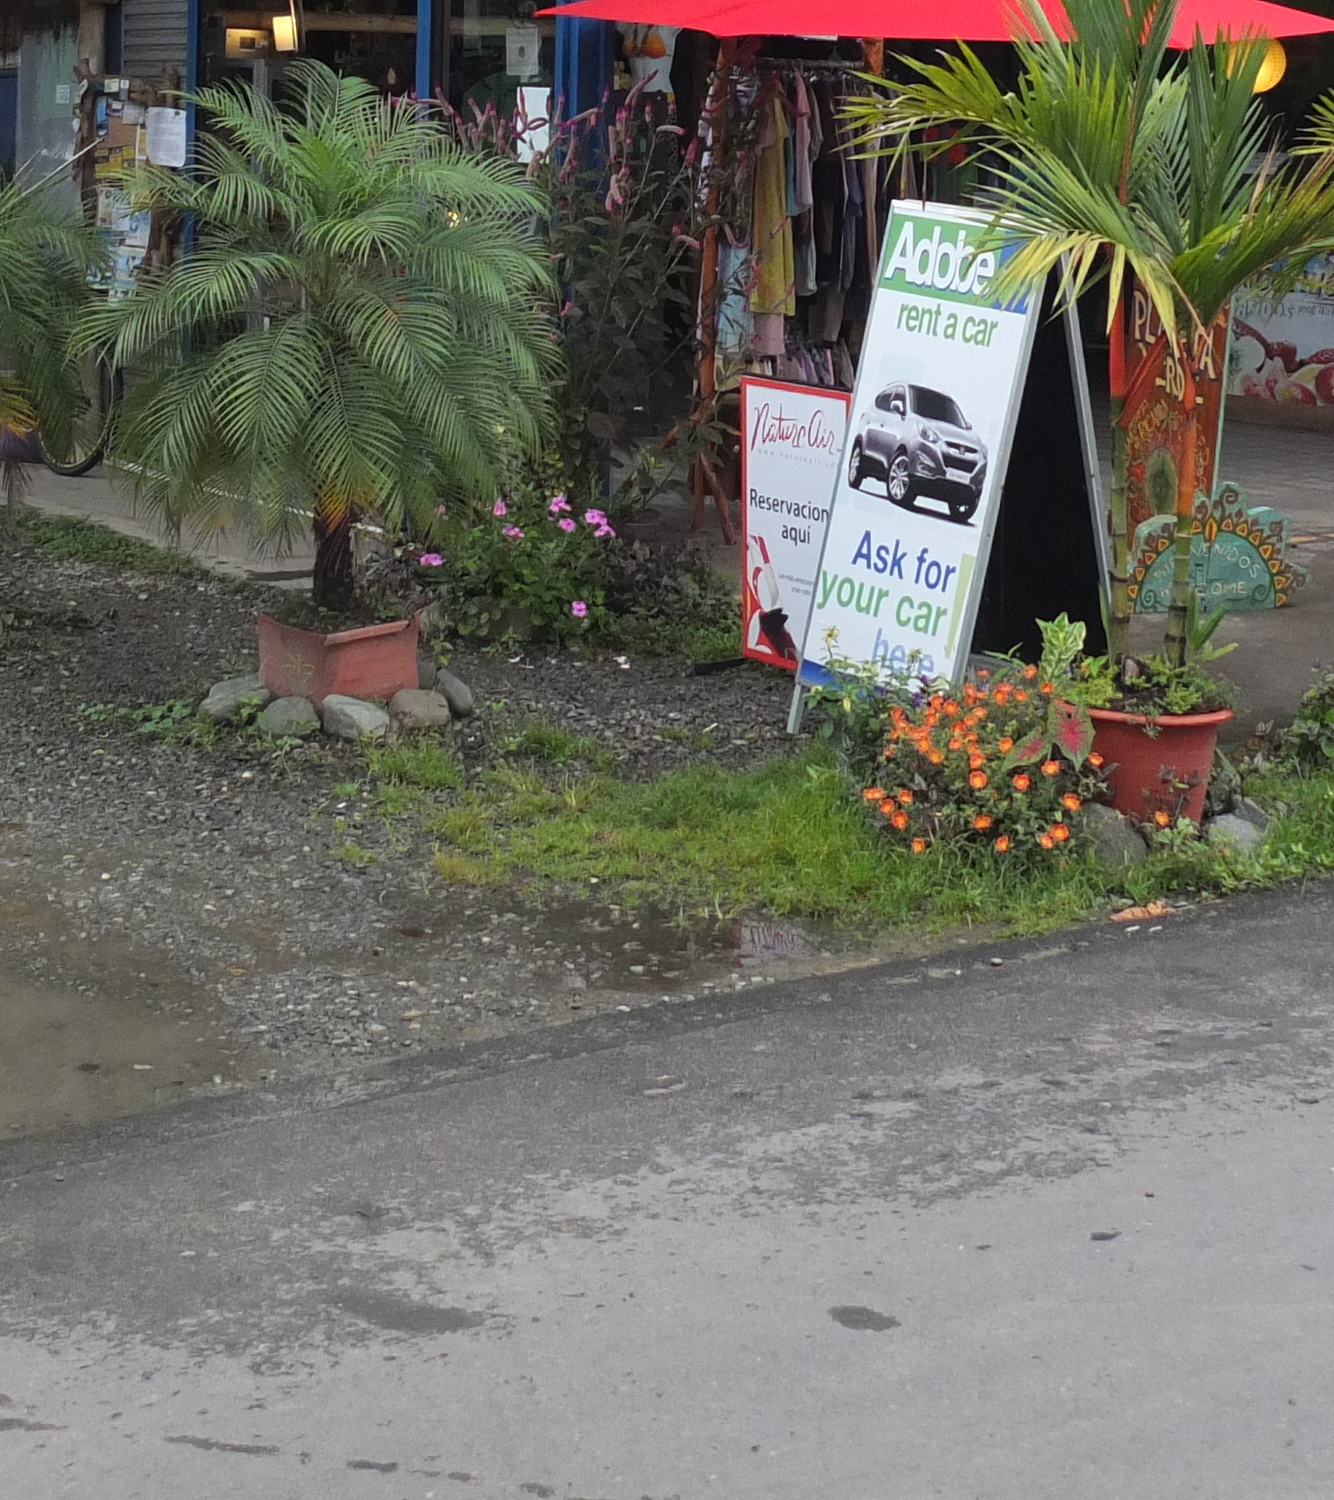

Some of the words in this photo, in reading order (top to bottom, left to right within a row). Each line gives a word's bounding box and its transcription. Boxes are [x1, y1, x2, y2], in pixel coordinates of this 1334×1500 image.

[884, 220, 996, 297] Adobe
[896, 302, 942, 337] rent
[943, 312, 958, 340] a
[962, 315, 999, 348] car
[781, 523, 812, 547] aquí
[851, 530, 905, 580] Ask
[916, 546, 957, 594] for
[816, 568, 889, 619] your
[895, 592, 948, 638] car
